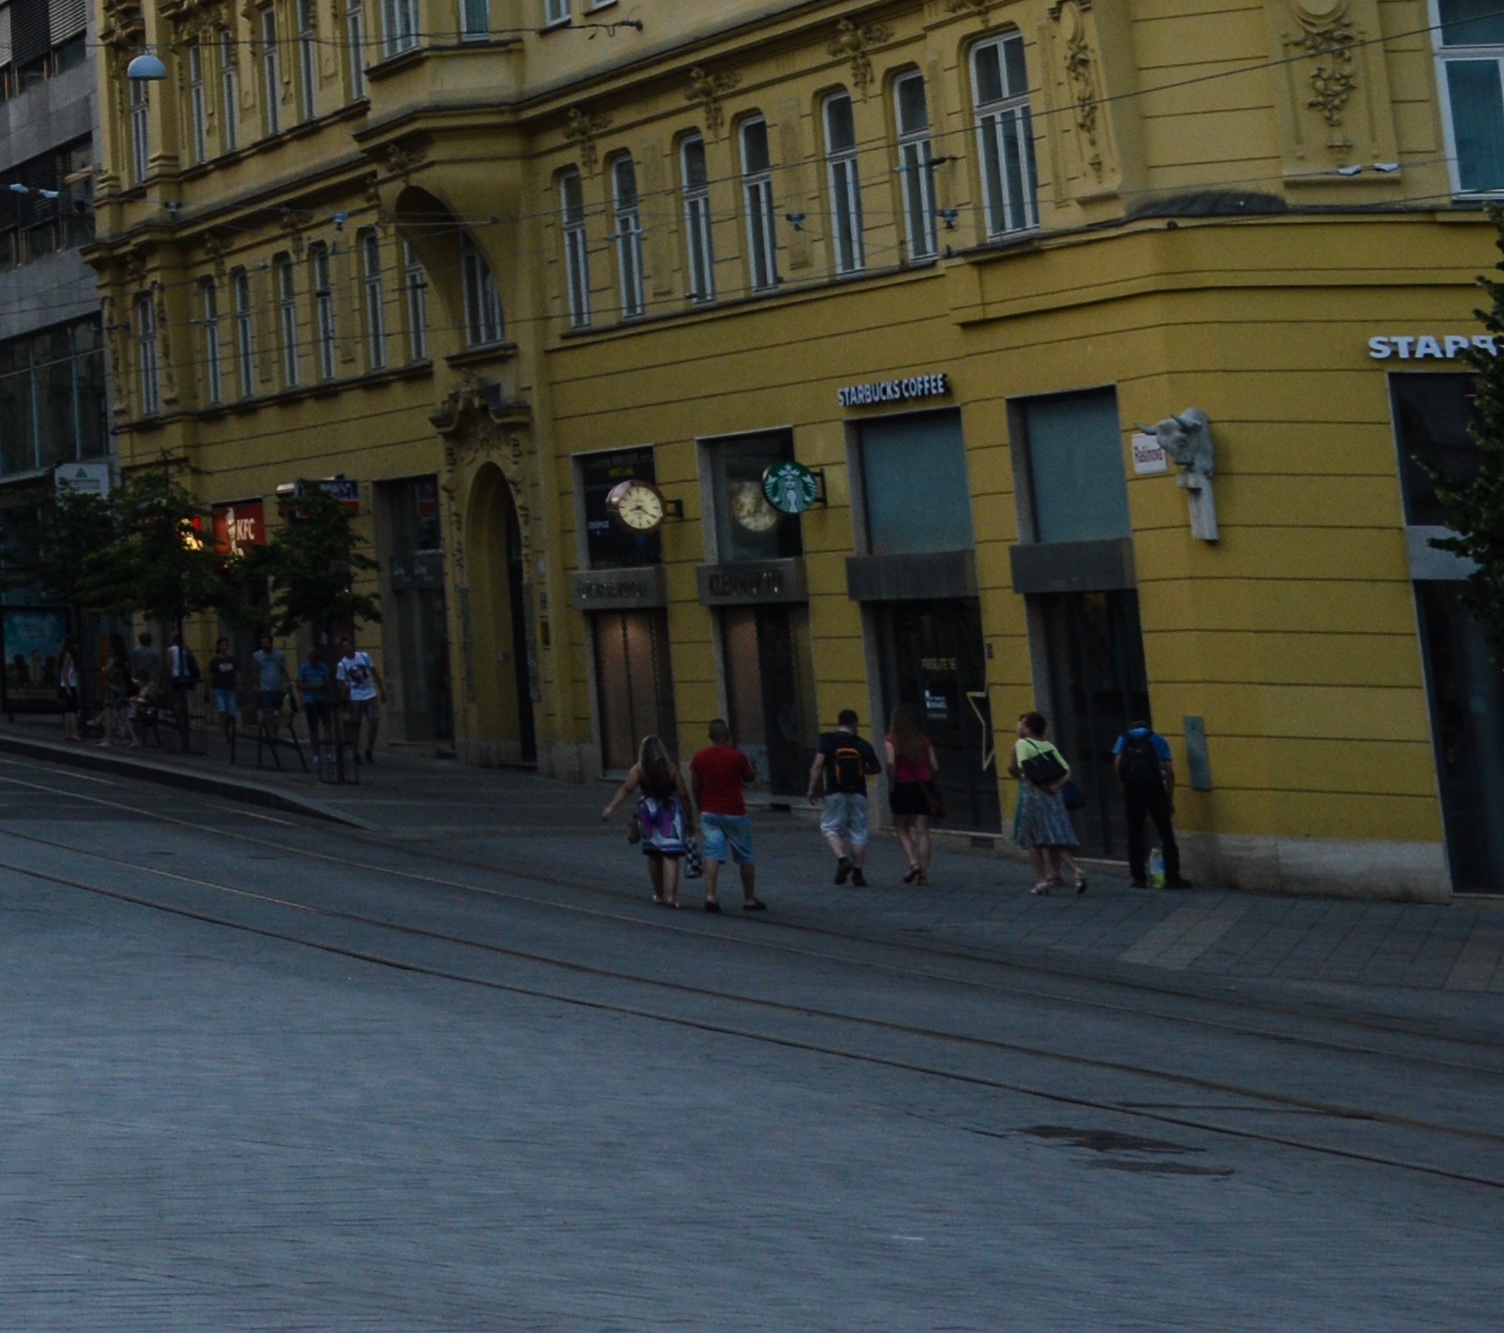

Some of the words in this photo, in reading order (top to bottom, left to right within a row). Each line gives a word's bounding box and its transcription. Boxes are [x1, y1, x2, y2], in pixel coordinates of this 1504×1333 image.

[837, 380, 900, 406] STARBUCKS
[901, 373, 946, 397] COFFEE
[237, 518, 256, 540] KFC
